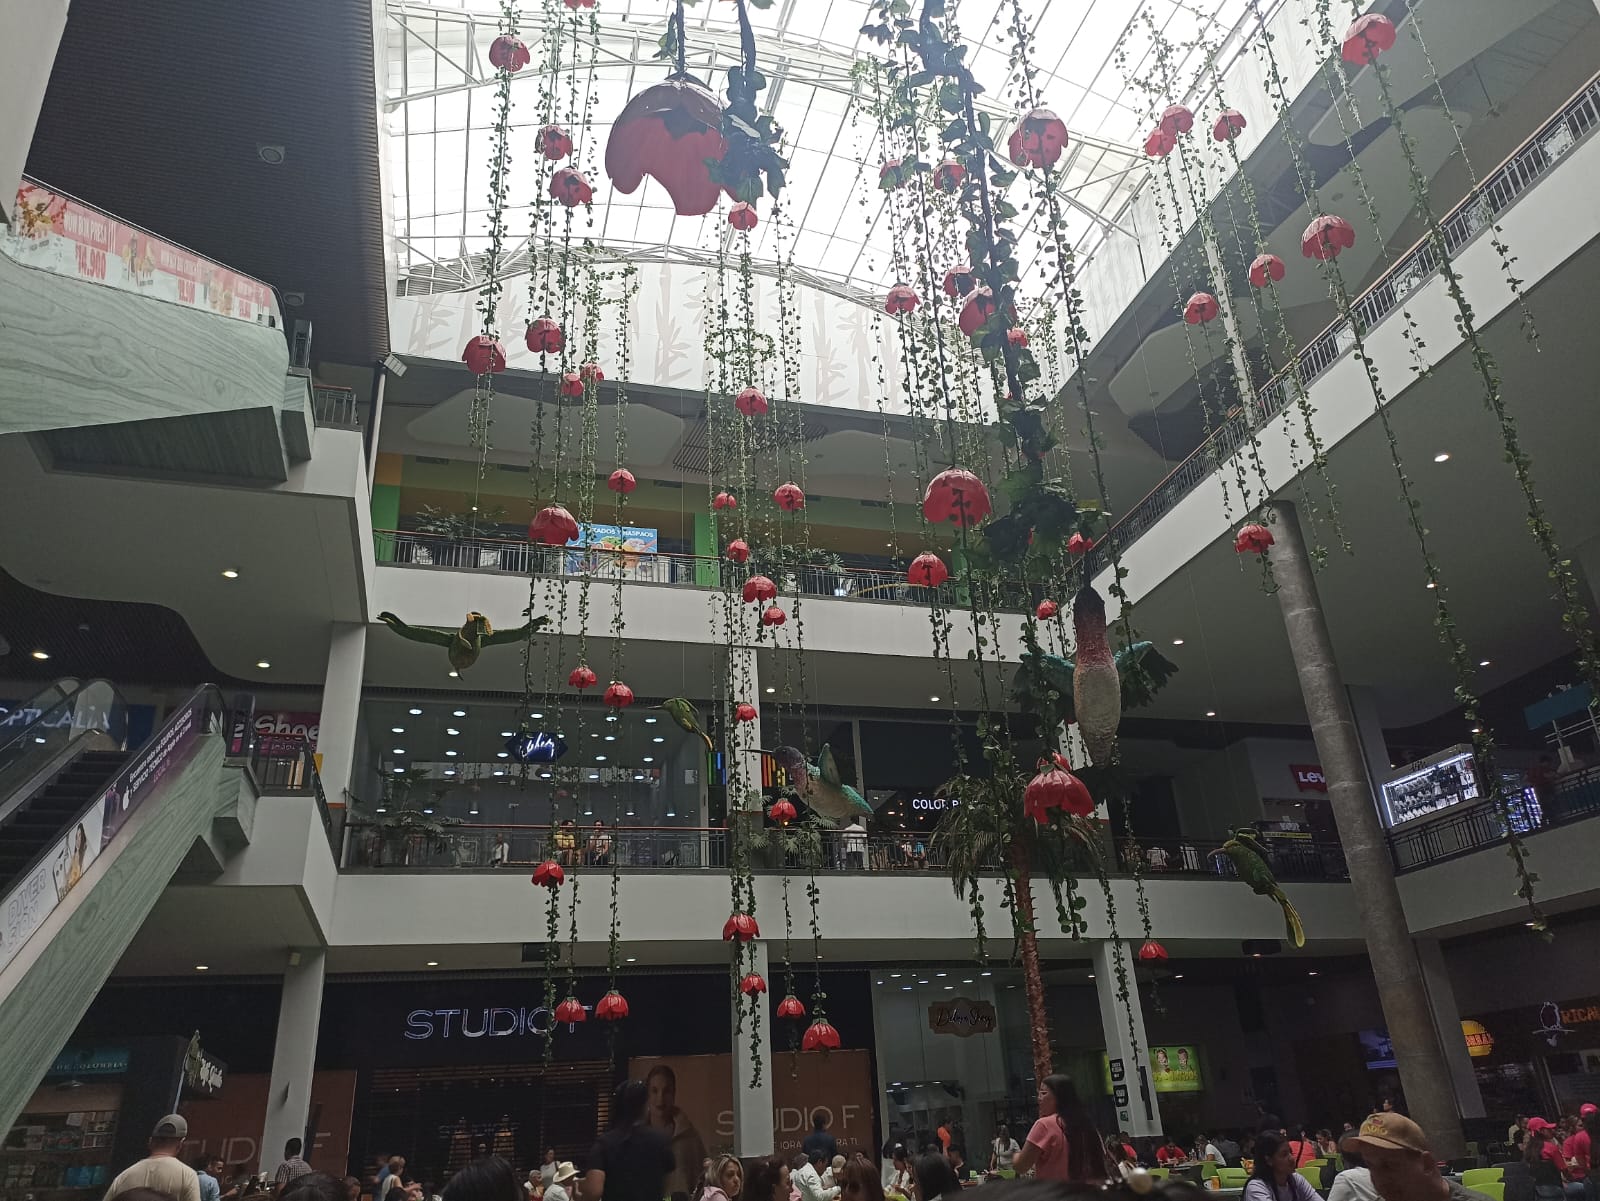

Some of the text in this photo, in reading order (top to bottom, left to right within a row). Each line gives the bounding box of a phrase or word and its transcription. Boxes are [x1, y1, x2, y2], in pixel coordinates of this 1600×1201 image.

[404, 1006, 558, 1040] STUDIO
[715, 1104, 860, 1136] SDIO F
